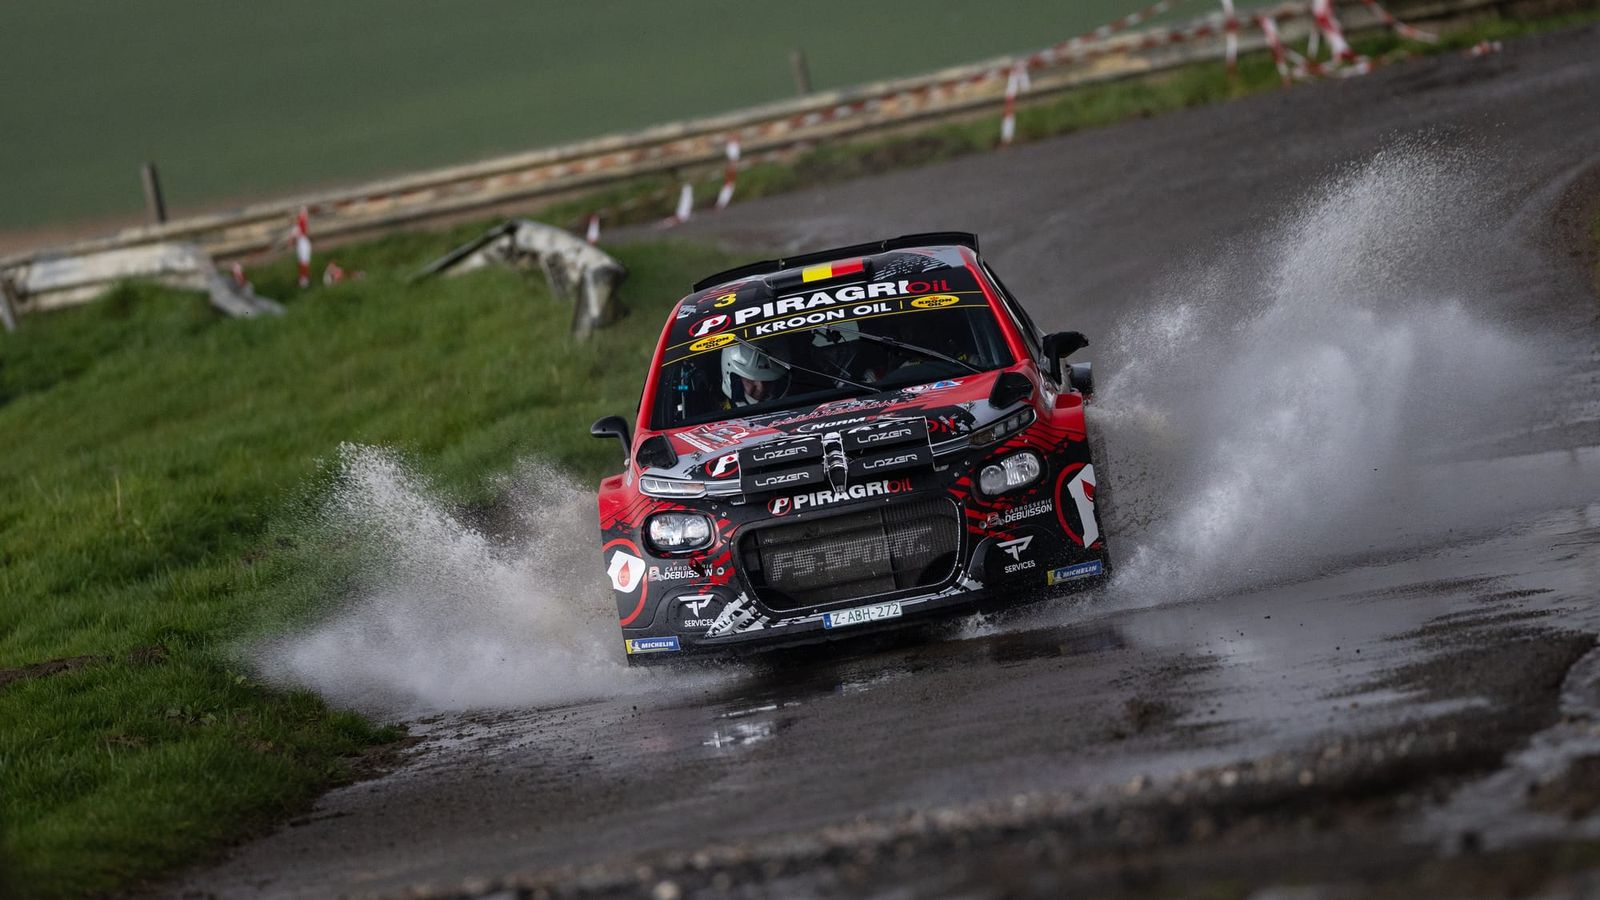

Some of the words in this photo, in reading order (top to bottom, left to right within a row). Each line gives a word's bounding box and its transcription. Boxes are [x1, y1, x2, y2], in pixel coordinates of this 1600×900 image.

[714, 293, 737, 308] 3
[755, 308, 845, 336] KROON
[852, 302, 892, 316] OIL
[857, 427, 912, 444] LAZER
[753, 446, 808, 462] LAZER
[863, 453, 918, 470] LAZER
[755, 471, 809, 487] LAZER
[1005, 503, 1053, 523] DEBUISSON
[664, 568, 713, 580] DEBUISSN
[1004, 560, 1036, 574] SERVICES
[1063, 566, 1097, 578] MICHELIN
[833, 602, 899, 625] Z-ABH-272
[684, 618, 714, 628] SERVICES
[641, 641, 674, 649] MICHELIN
